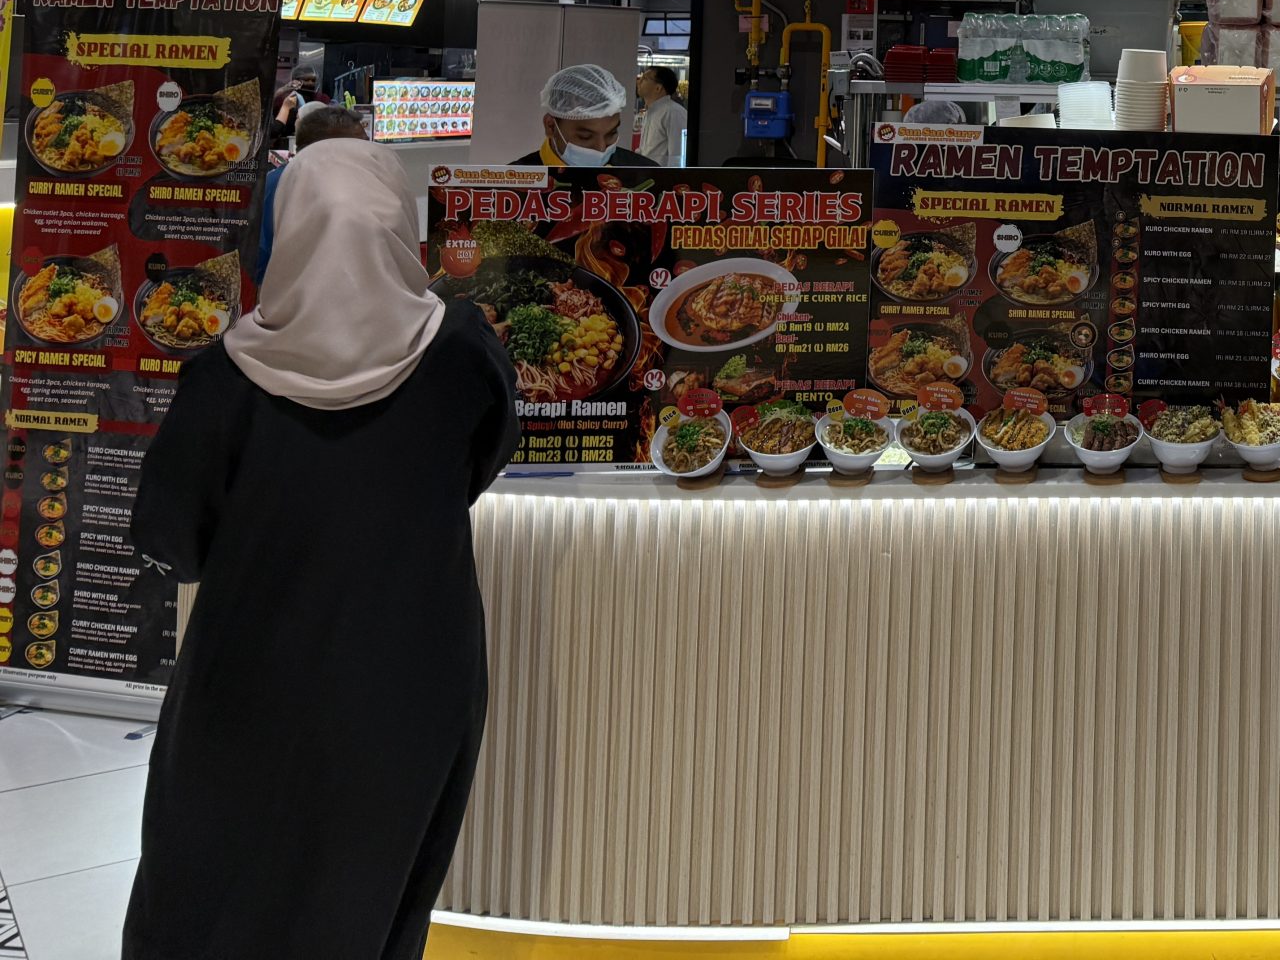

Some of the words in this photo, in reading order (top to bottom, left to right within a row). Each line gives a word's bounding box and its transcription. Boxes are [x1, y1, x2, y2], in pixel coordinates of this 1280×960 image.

[76, 41, 151, 59] SPECIAL
[155, 43, 219, 62] RAMEN
[897, 127, 921, 137] Sun
[921, 127, 944, 138] San
[945, 128, 982, 139] Curry
[889, 142, 1024, 180] RAMEN
[1033, 144, 1266, 188] TEMPTATION
[453, 168, 480, 180] Sun
[480, 169, 505, 181] San
[505, 170, 546, 182] Curry
[28, 181, 53, 194] CURRY
[54, 182, 85, 196] RAMEN
[87, 184, 124, 198] SPECIAL
[149, 186, 172, 200] SHIRO
[173, 187, 204, 201] RAMEN
[205, 188, 241, 203] SPECIAL
[444, 188, 572, 223] PEDAS
[581, 189, 722, 224] BERAPI
[731, 190, 863, 224] SERIES
[919, 196, 990, 211] SPECIAL
[994, 198, 1055, 213] RAMEN
[1159, 202, 1209, 213] NORMAL
[1212, 204, 1255, 215] RAMEN
[671, 225, 726, 250] PEDAS
[726, 225, 770, 250] GILA!
[770, 225, 824, 250] SEDAP
[824, 226, 867, 250] GILA!
[873, 229, 899, 237] CURRY
[446, 239, 477, 248] EXTRA
[880, 305, 901, 315] CURRY
[902, 305, 925, 315] RAMEN
[926, 306, 951, 316] SPECIAL
[1008, 309, 1027, 318] SHIRO
[1028, 310, 1050, 319] RAMEN
[1051, 310, 1076, 320] SPECIAL
[14, 349, 37, 364] SPICY
[38, 351, 70, 366] RAMEN
[72, 352, 107, 368] SPECIAL
[795, 392, 833, 402] BENTO
[514, 399, 567, 419] Berapi
[571, 399, 627, 417] Ramen
[14, 413, 53, 426] NORMAL
[54, 416, 89, 427] RAMEN
[528, 436, 562, 449] Rm20
[565, 436, 579, 449] (L)
[582, 435, 614, 448] RM25
[528, 450, 561, 462] Rm23
[565, 450, 579, 463] (L)
[582, 449, 614, 462] RM28
[76, 562, 93, 571] SHIRO
[93, 563, 119, 574] CHICKEN
[119, 565, 140, 576] RAMEN
